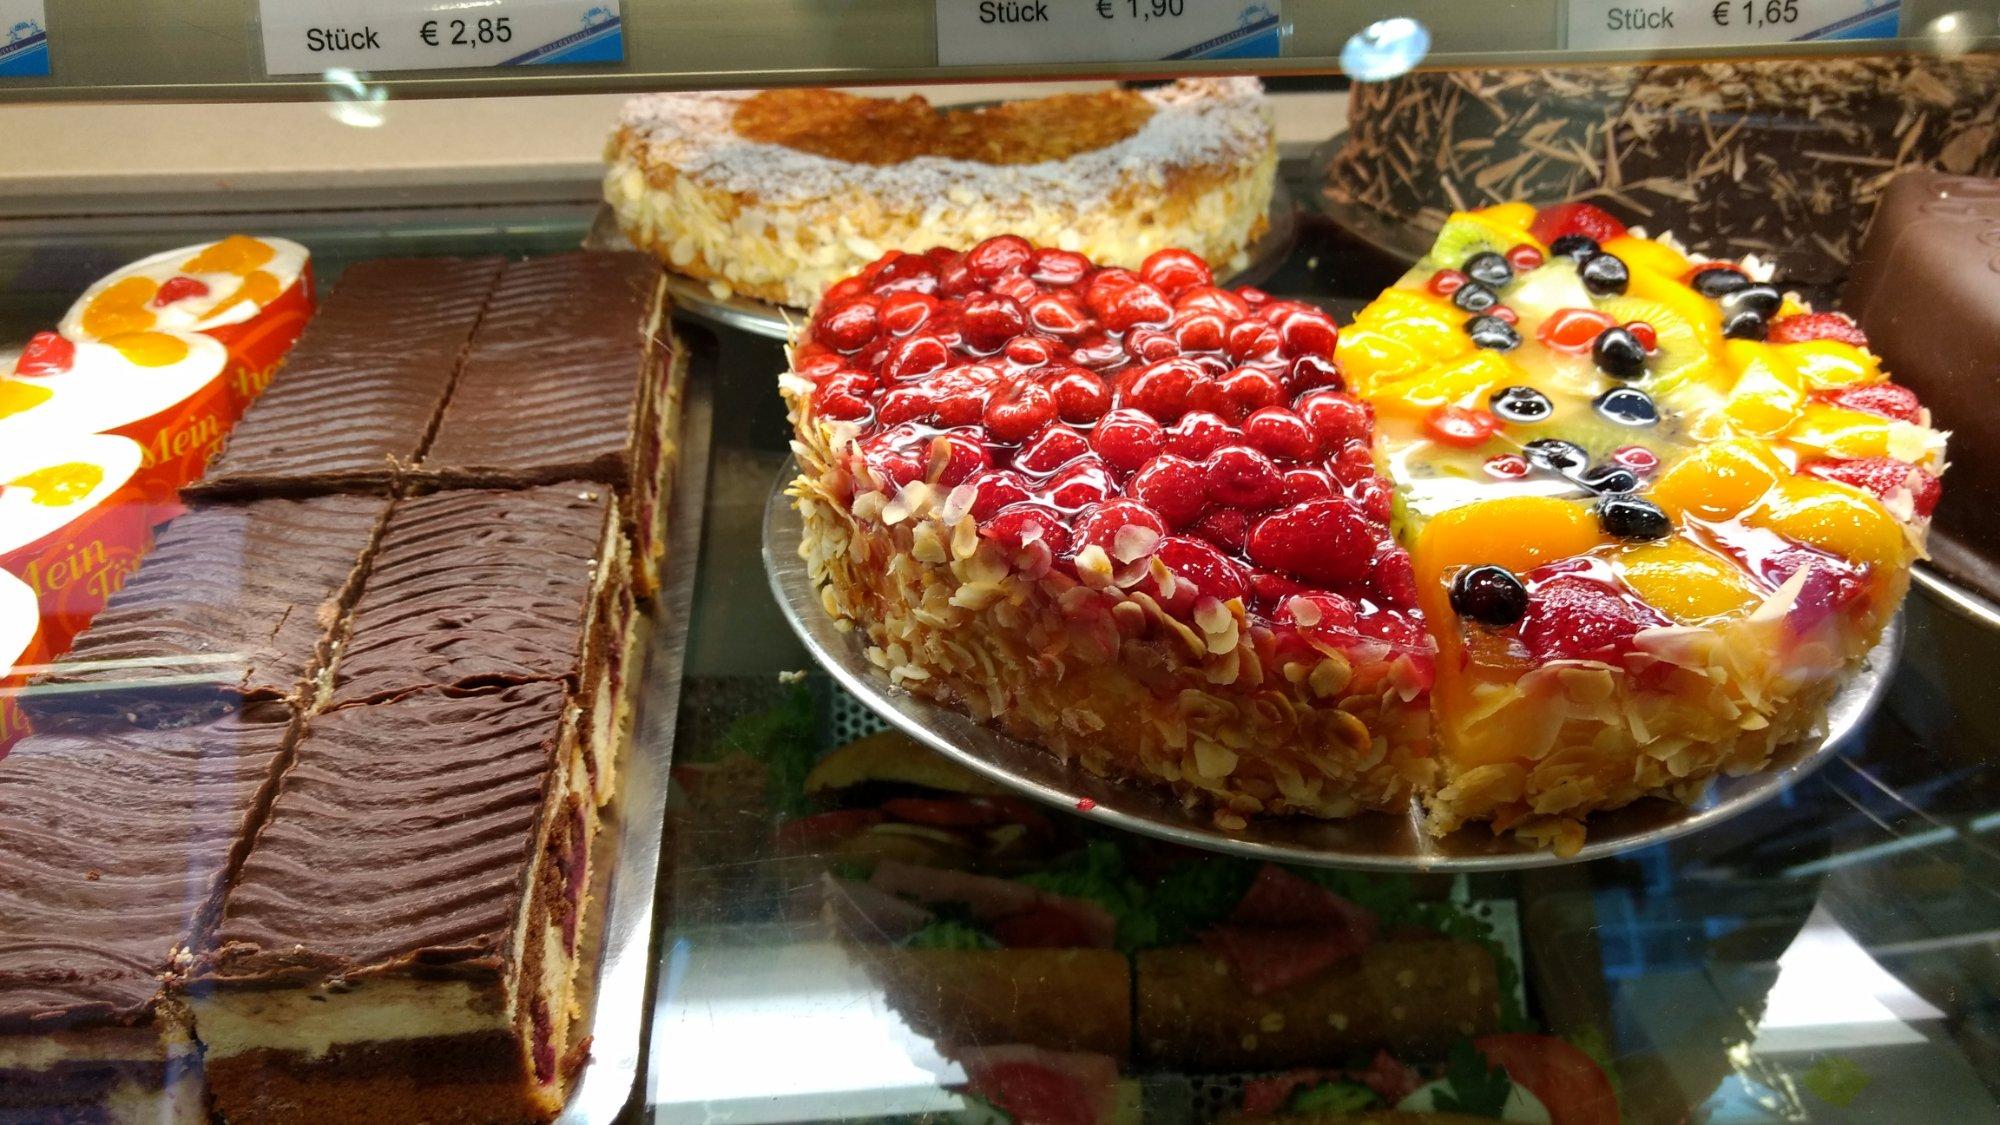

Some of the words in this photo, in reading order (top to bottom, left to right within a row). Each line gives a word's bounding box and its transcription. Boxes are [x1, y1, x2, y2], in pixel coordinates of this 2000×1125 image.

[979, 0, 1048, 23] Stück
[1096, 0, 1114, 18] €
[1126, 0, 1184, 22] 1,90
[1607, 7, 1674, 31] Stück
[1712, 1, 1730, 26] €
[1743, 0, 1799, 27] 1,65
[307, 26, 380, 51] Stück
[420, 20, 439, 46] €
[450, 17, 512, 48] 2,85
[141, 413, 218, 469] Mein
